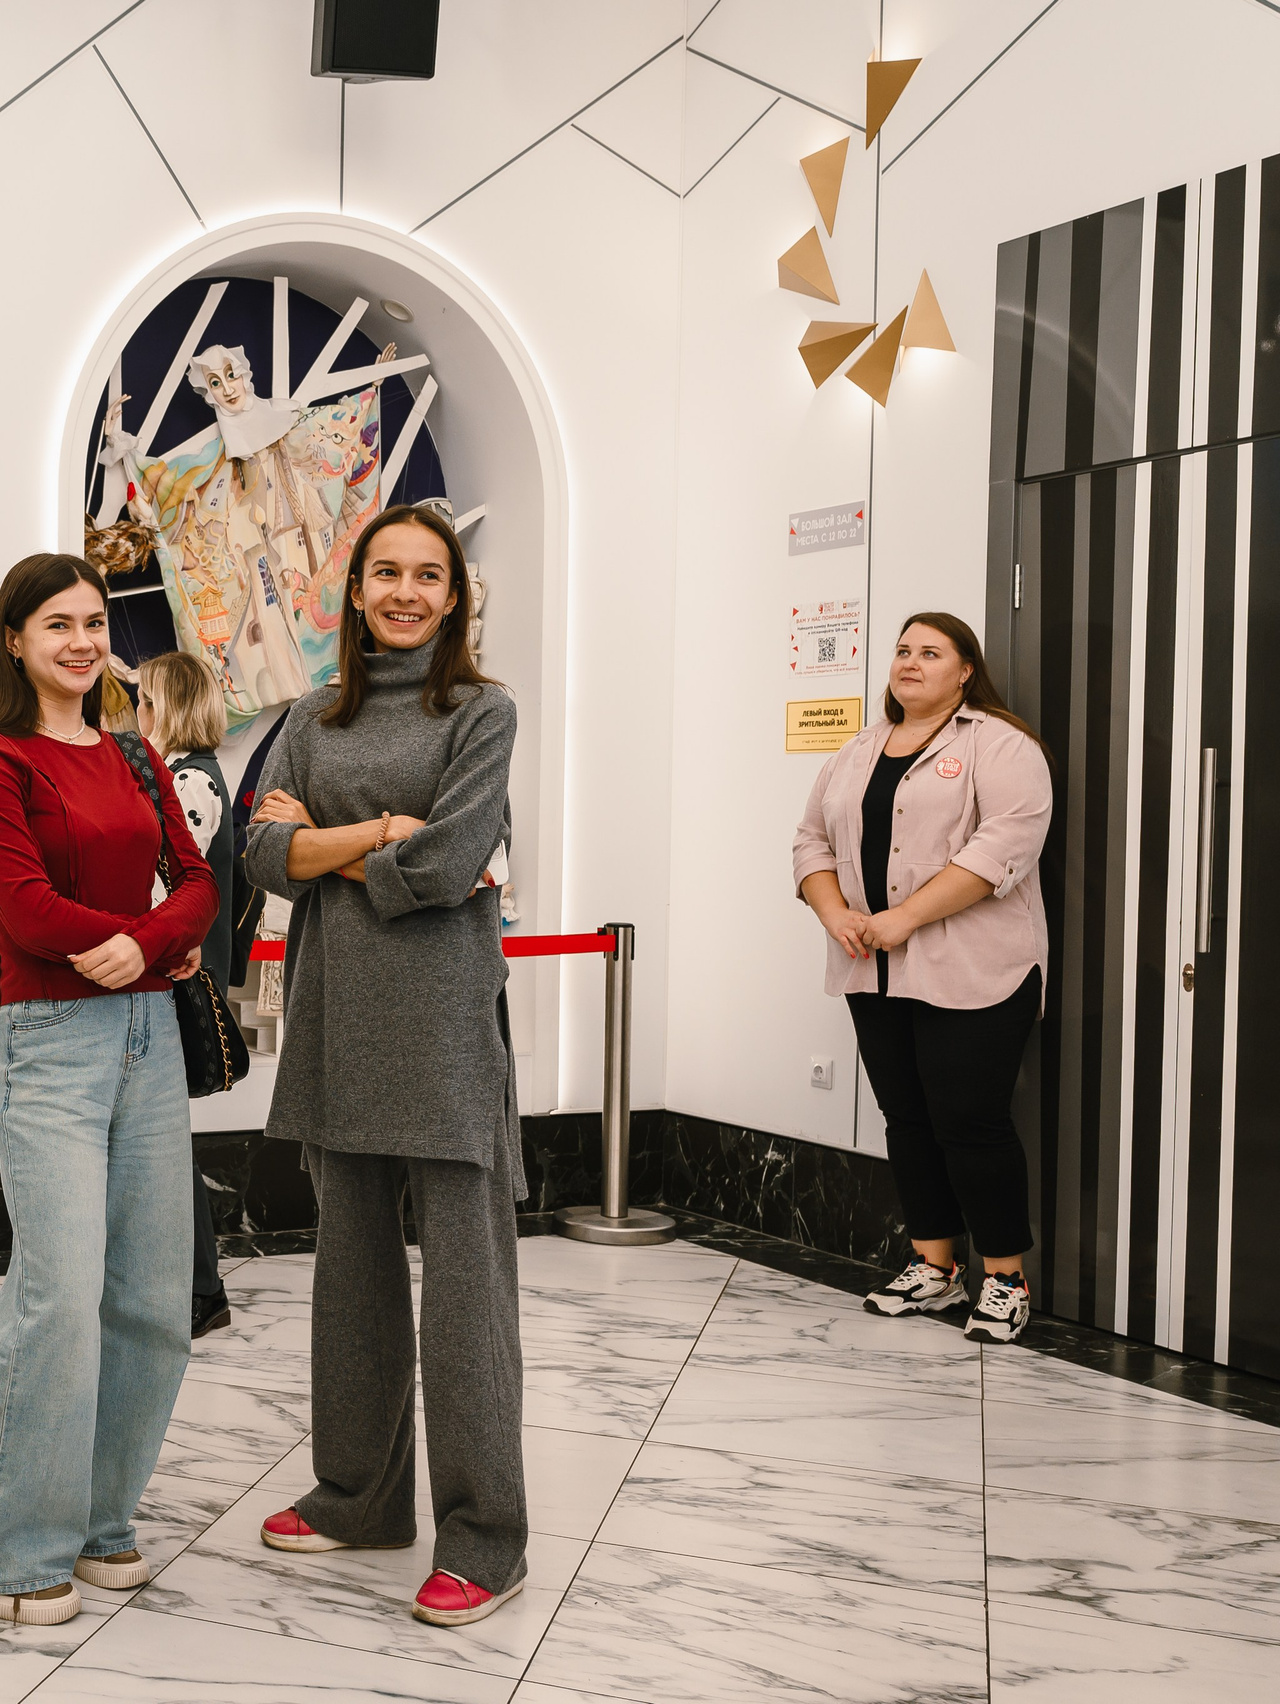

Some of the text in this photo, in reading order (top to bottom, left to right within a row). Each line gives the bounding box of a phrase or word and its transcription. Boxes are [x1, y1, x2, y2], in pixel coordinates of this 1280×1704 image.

[801, 512, 852, 531] БОЛЬШОЙ ЗАЛ
[796, 528, 857, 546] МЕСТА С 12 ПО 22
[802, 708, 822, 717] ЛЕВЫЙ
[823, 708, 839, 717] ВХОД
[798, 718, 848, 728] ЗРИТЕЛЬНЫЙ ЗАЛ
